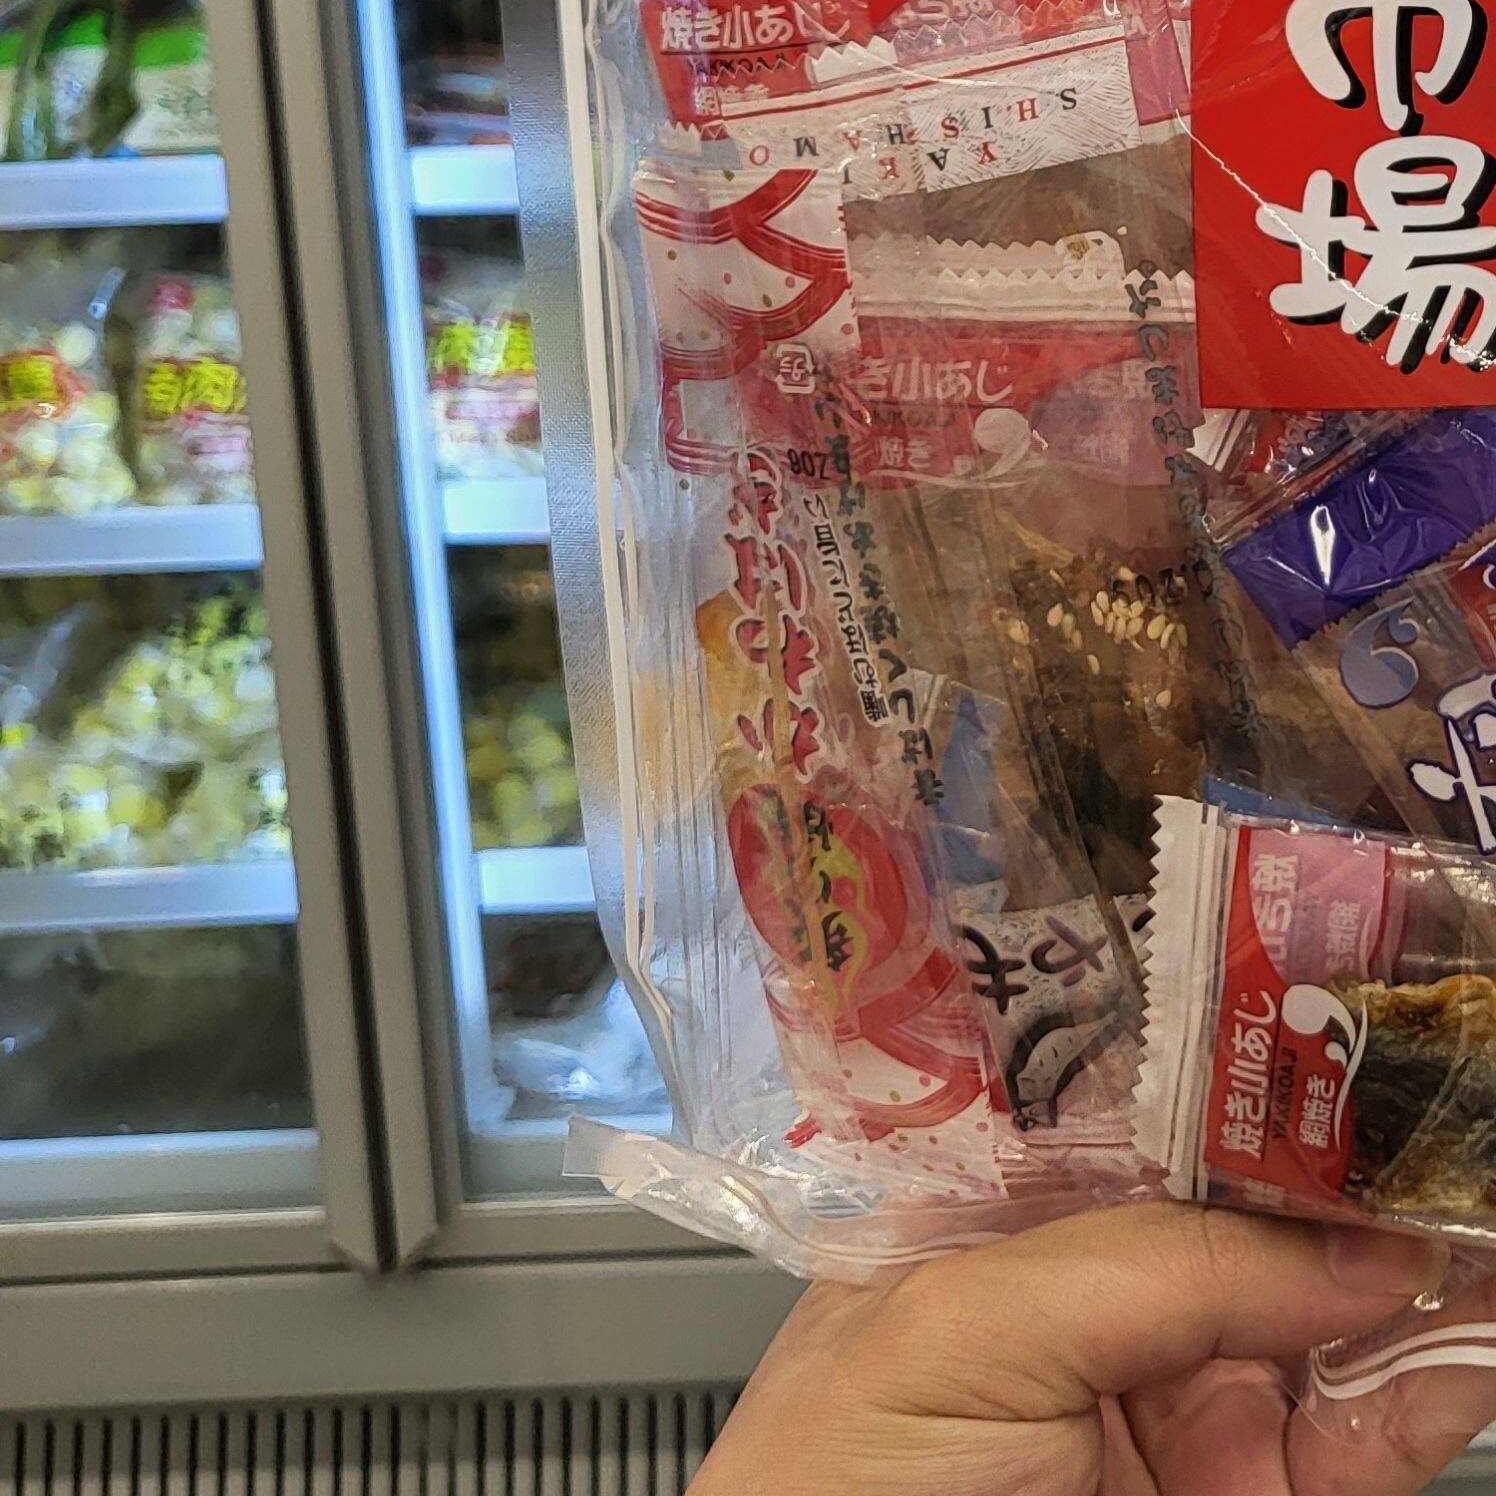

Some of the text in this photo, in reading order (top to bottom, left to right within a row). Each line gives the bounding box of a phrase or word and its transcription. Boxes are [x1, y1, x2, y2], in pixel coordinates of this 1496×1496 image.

[1219, 989, 1276, 1159] 焼き小あじ
[1272, 1048, 1297, 1140] YAKIKOAJI
[1299, 1075, 1336, 1150] 網焼き
